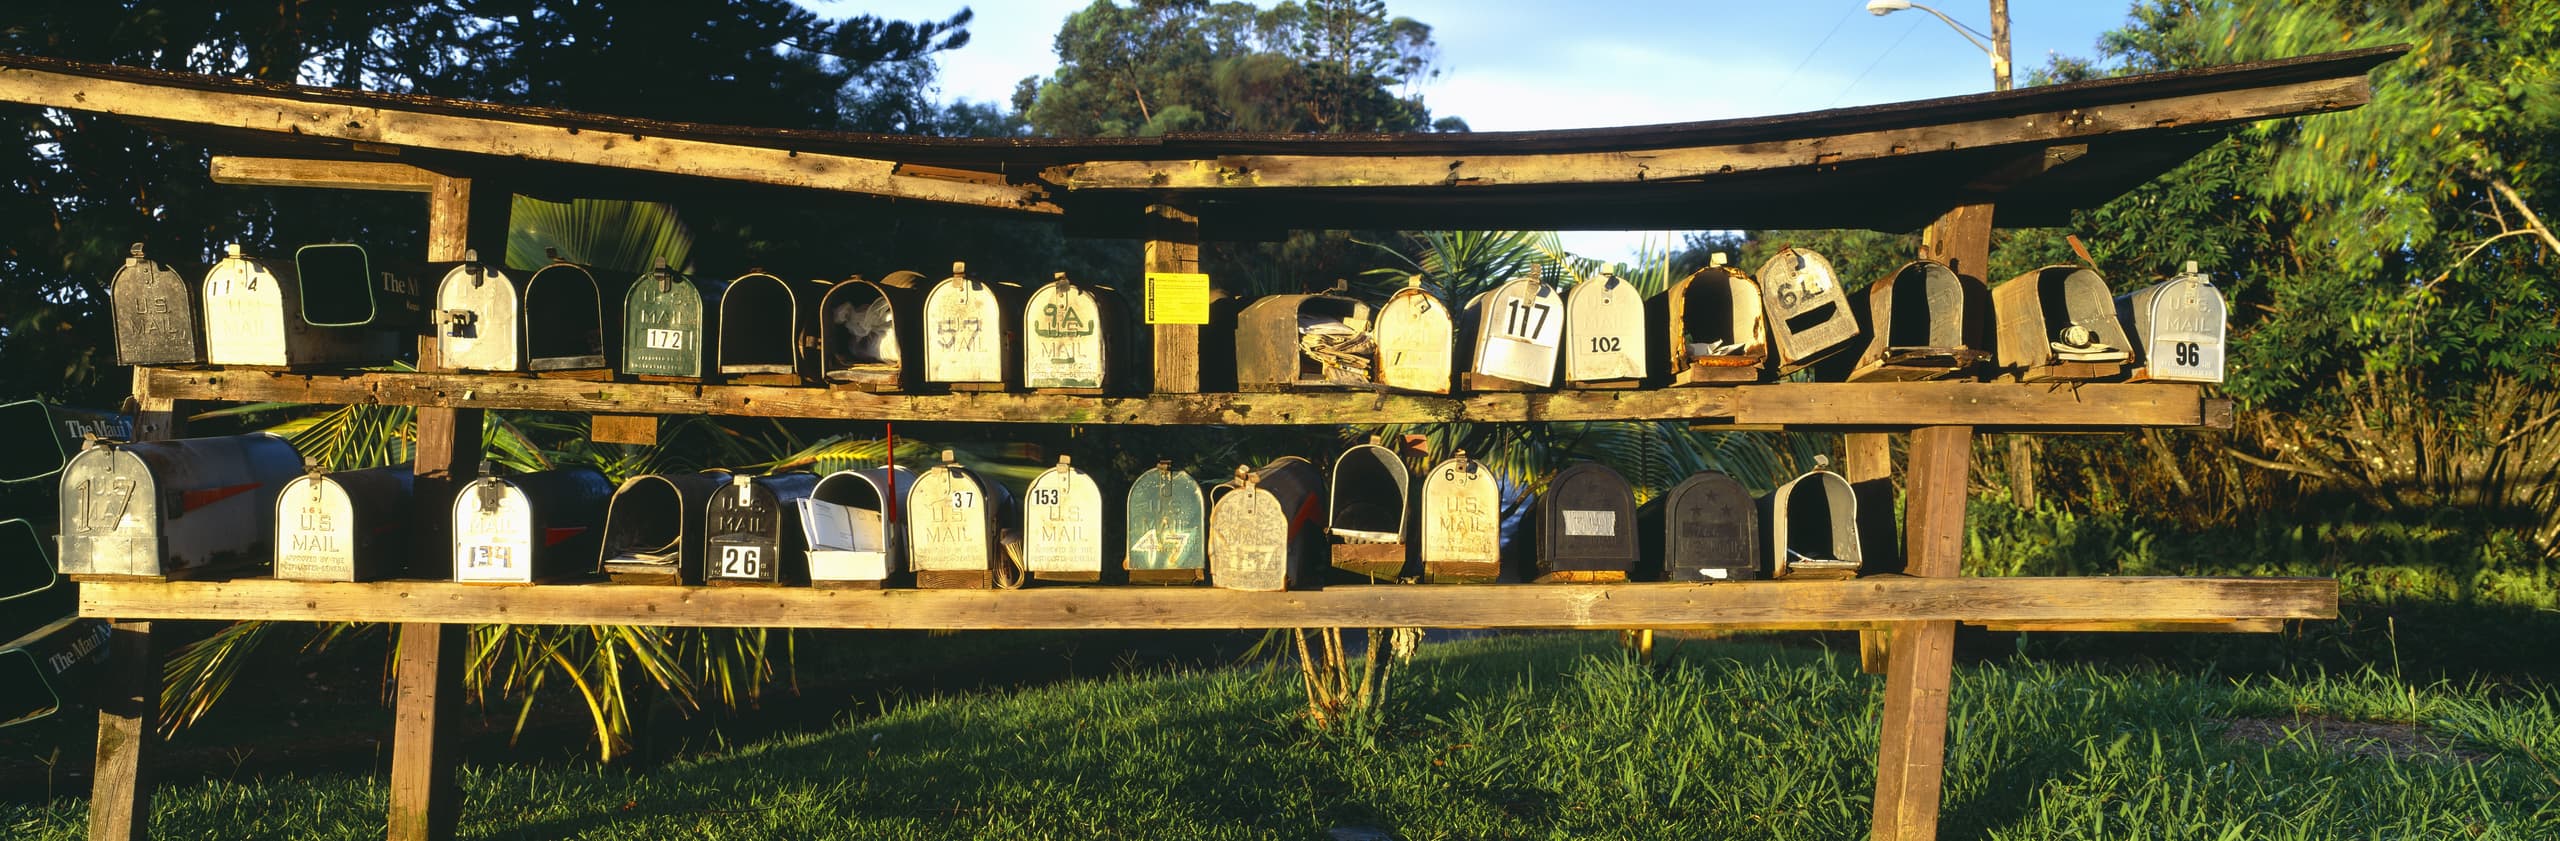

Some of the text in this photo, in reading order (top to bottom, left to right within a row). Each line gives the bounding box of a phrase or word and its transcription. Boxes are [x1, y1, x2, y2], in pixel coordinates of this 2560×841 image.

[381, 272, 405, 294] The
[135, 297, 171, 314] U.S.
[643, 290, 689, 306] U.S.
[2169, 295, 2211, 312] U.S.
[641, 309, 689, 325] MAIL
[1043, 303, 1083, 328] 9A
[1508, 299, 1550, 339] 117
[129, 319, 177, 336] MAIL
[2165, 317, 2211, 332] MAIL
[651, 332, 681, 349] 172
[937, 318, 983, 351] 57
[1041, 341, 1087, 359] MAIL
[1591, 337, 1621, 353] 102
[2175, 341, 2200, 367] 96
[65, 420, 92, 438] The
[94, 419, 127, 438] Maui
[722, 496, 766, 513] U.S.
[954, 492, 973, 508] 37
[1034, 489, 1059, 505] 153
[1446, 495, 1478, 514] U.S.
[77, 479, 136, 534] 17
[932, 506, 967, 523] U.S.
[1049, 504, 1084, 522] U.S.
[300, 514, 335, 532] U.S.
[719, 517, 766, 532] MAIL
[1440, 517, 1486, 533] MAIL
[926, 527, 973, 543] MAIL
[1042, 525, 1089, 542] MAIL
[292, 534, 339, 553] MAIL
[1131, 528, 1191, 566] 47
[725, 548, 756, 576] 26
[49, 652, 76, 674] The
[72, 628, 102, 660] Maui
